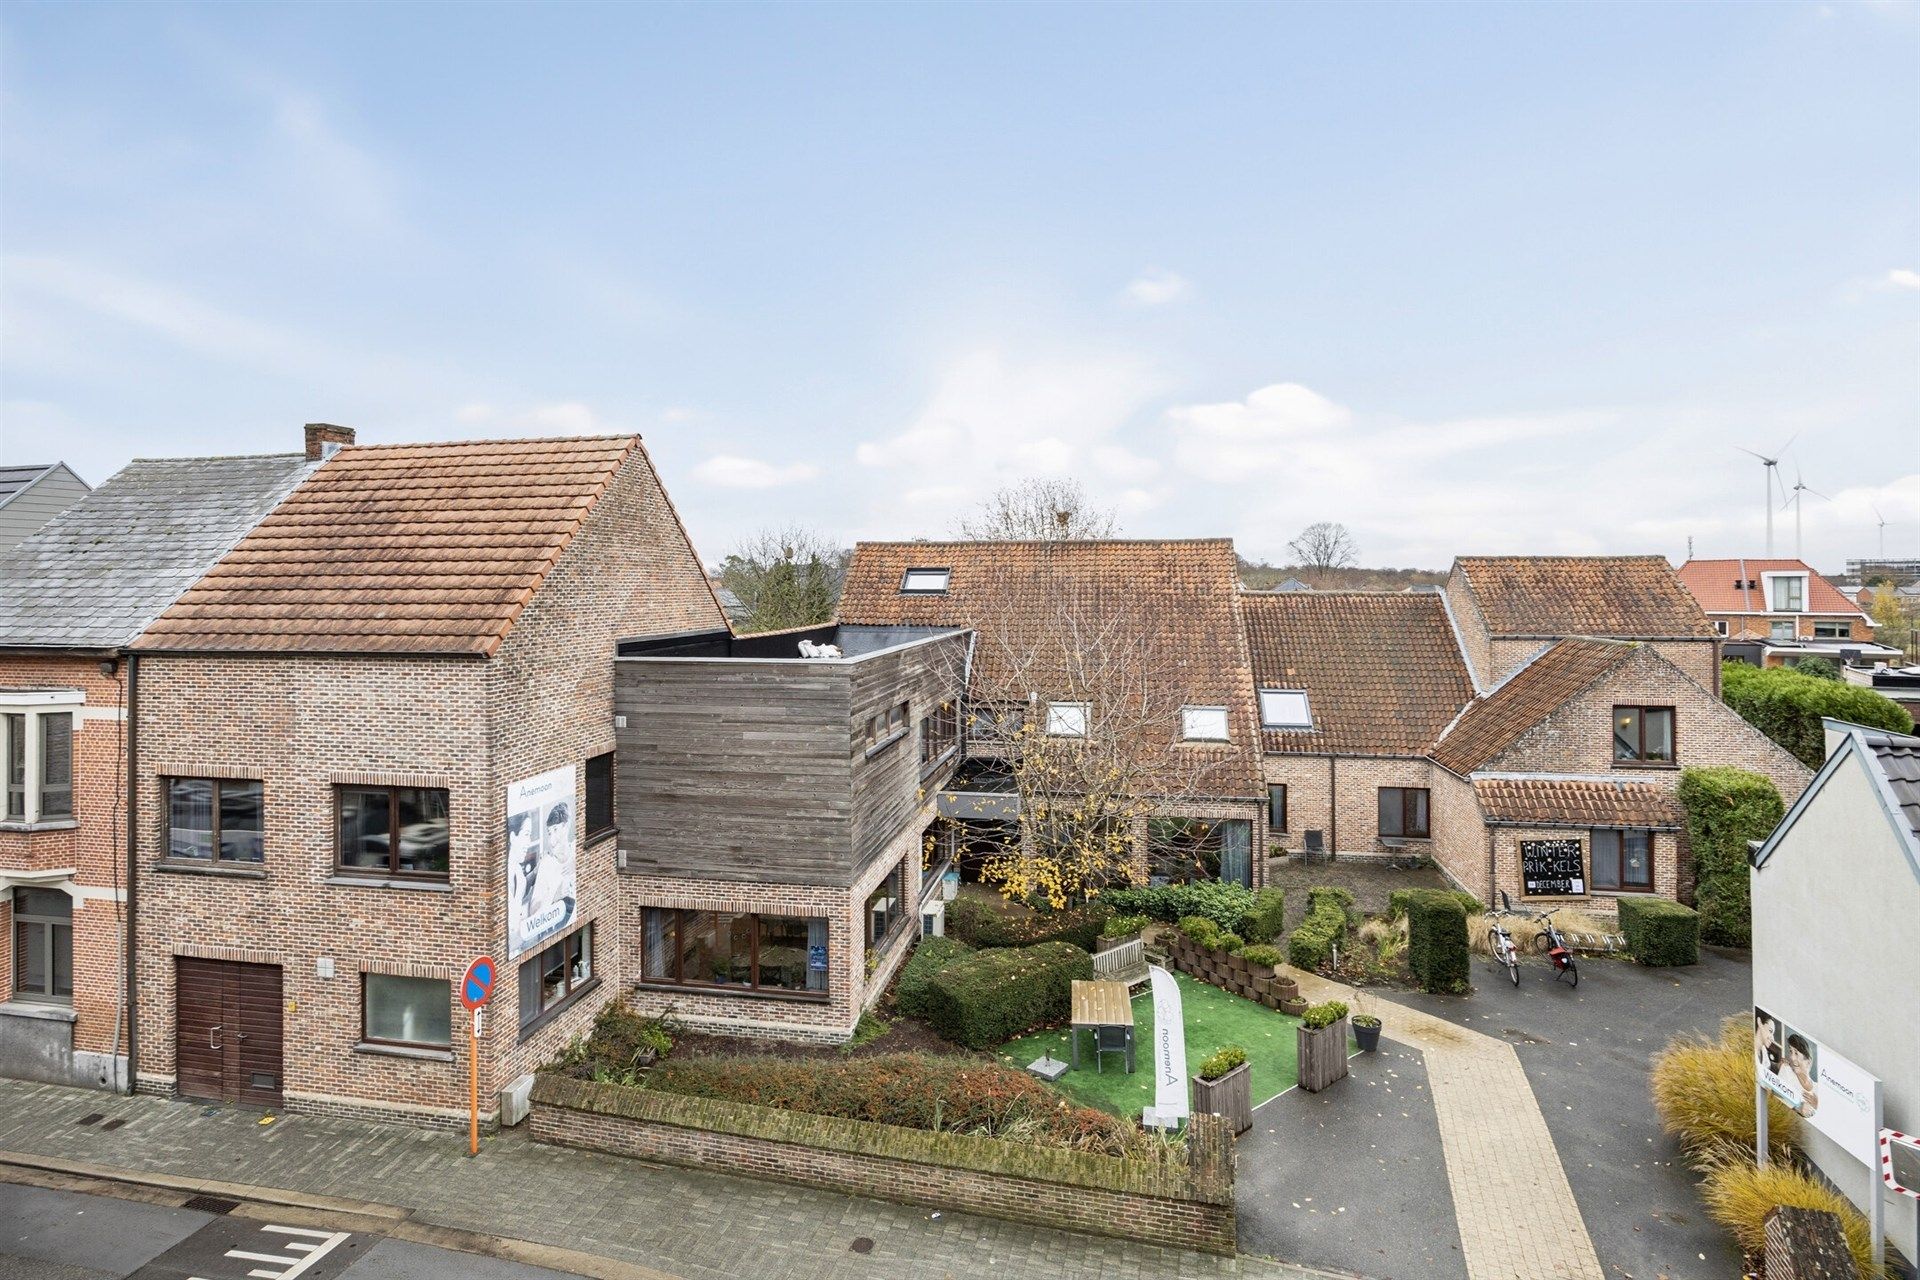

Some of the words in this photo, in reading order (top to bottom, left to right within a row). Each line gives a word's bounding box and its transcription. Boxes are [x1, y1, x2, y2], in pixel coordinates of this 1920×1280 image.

[520, 782, 552, 798] Anemoon
[1525, 844, 1577, 857] WINTER
[1536, 880, 1570, 889] DECEMBER
[526, 907, 560, 932] Welkom
[1764, 1070, 1794, 1099] Welkom
[1821, 1068, 1854, 1097] Anemoon
